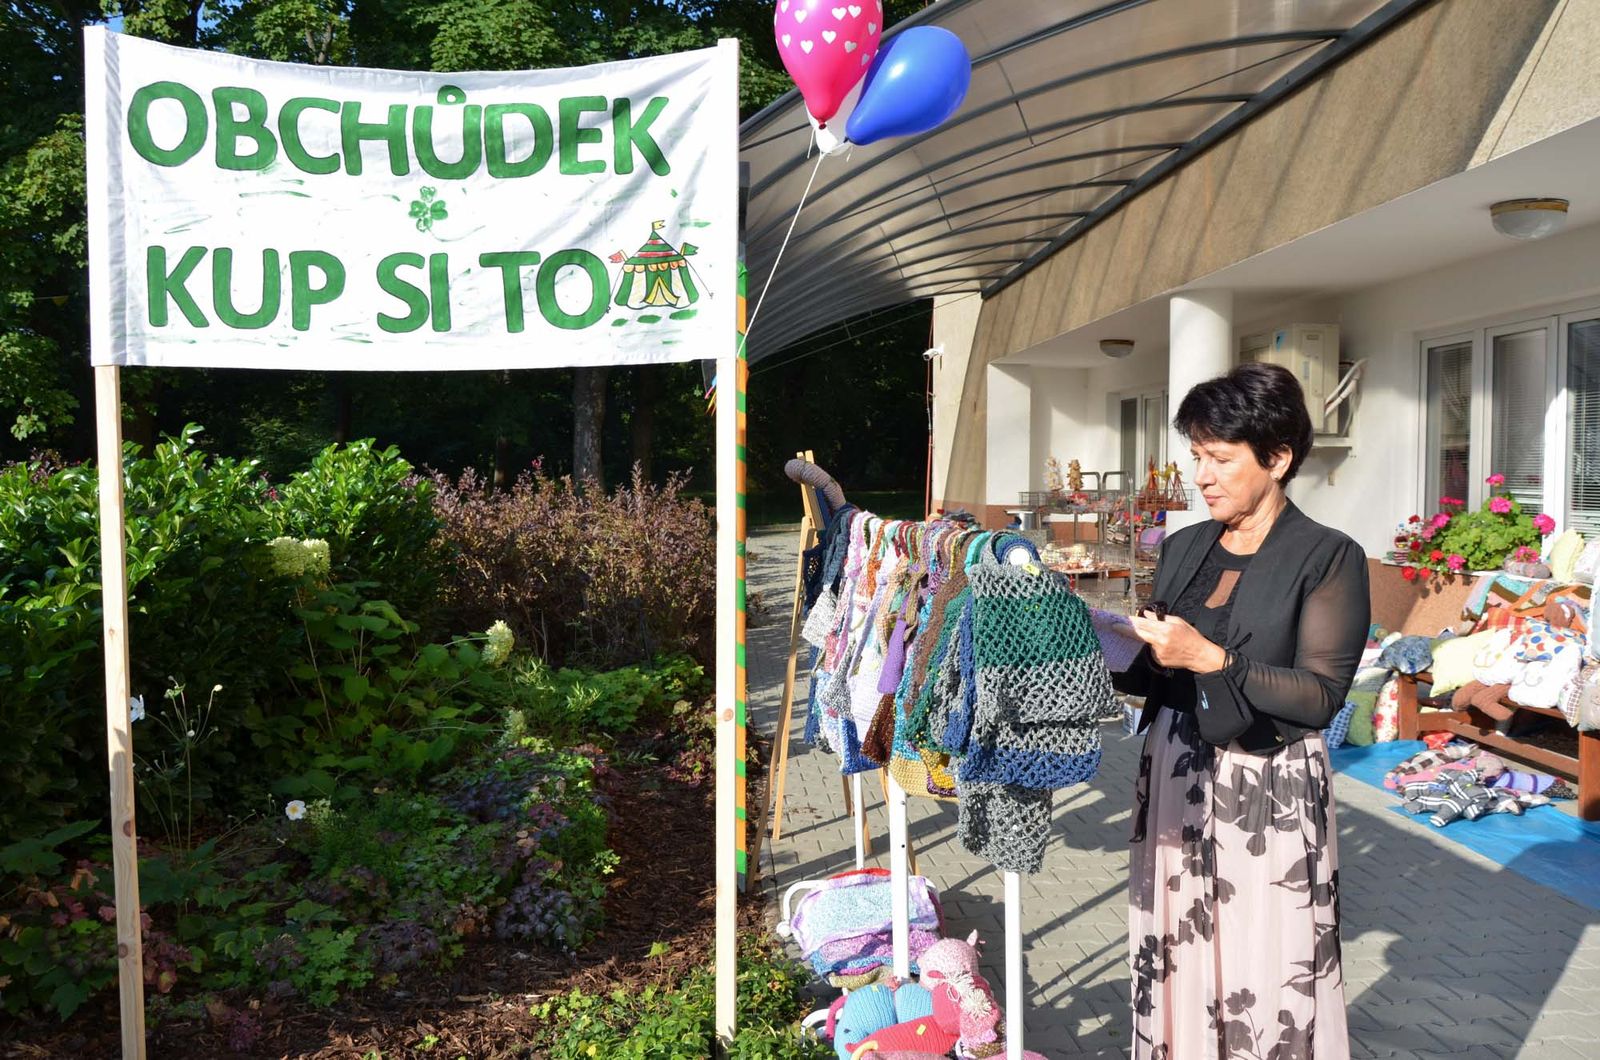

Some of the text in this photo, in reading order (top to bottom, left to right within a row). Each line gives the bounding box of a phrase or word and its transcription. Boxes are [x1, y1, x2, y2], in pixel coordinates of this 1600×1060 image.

[127, 81, 671, 180] OBCHŮDEK
[146, 246, 608, 333] KUP SI TO
